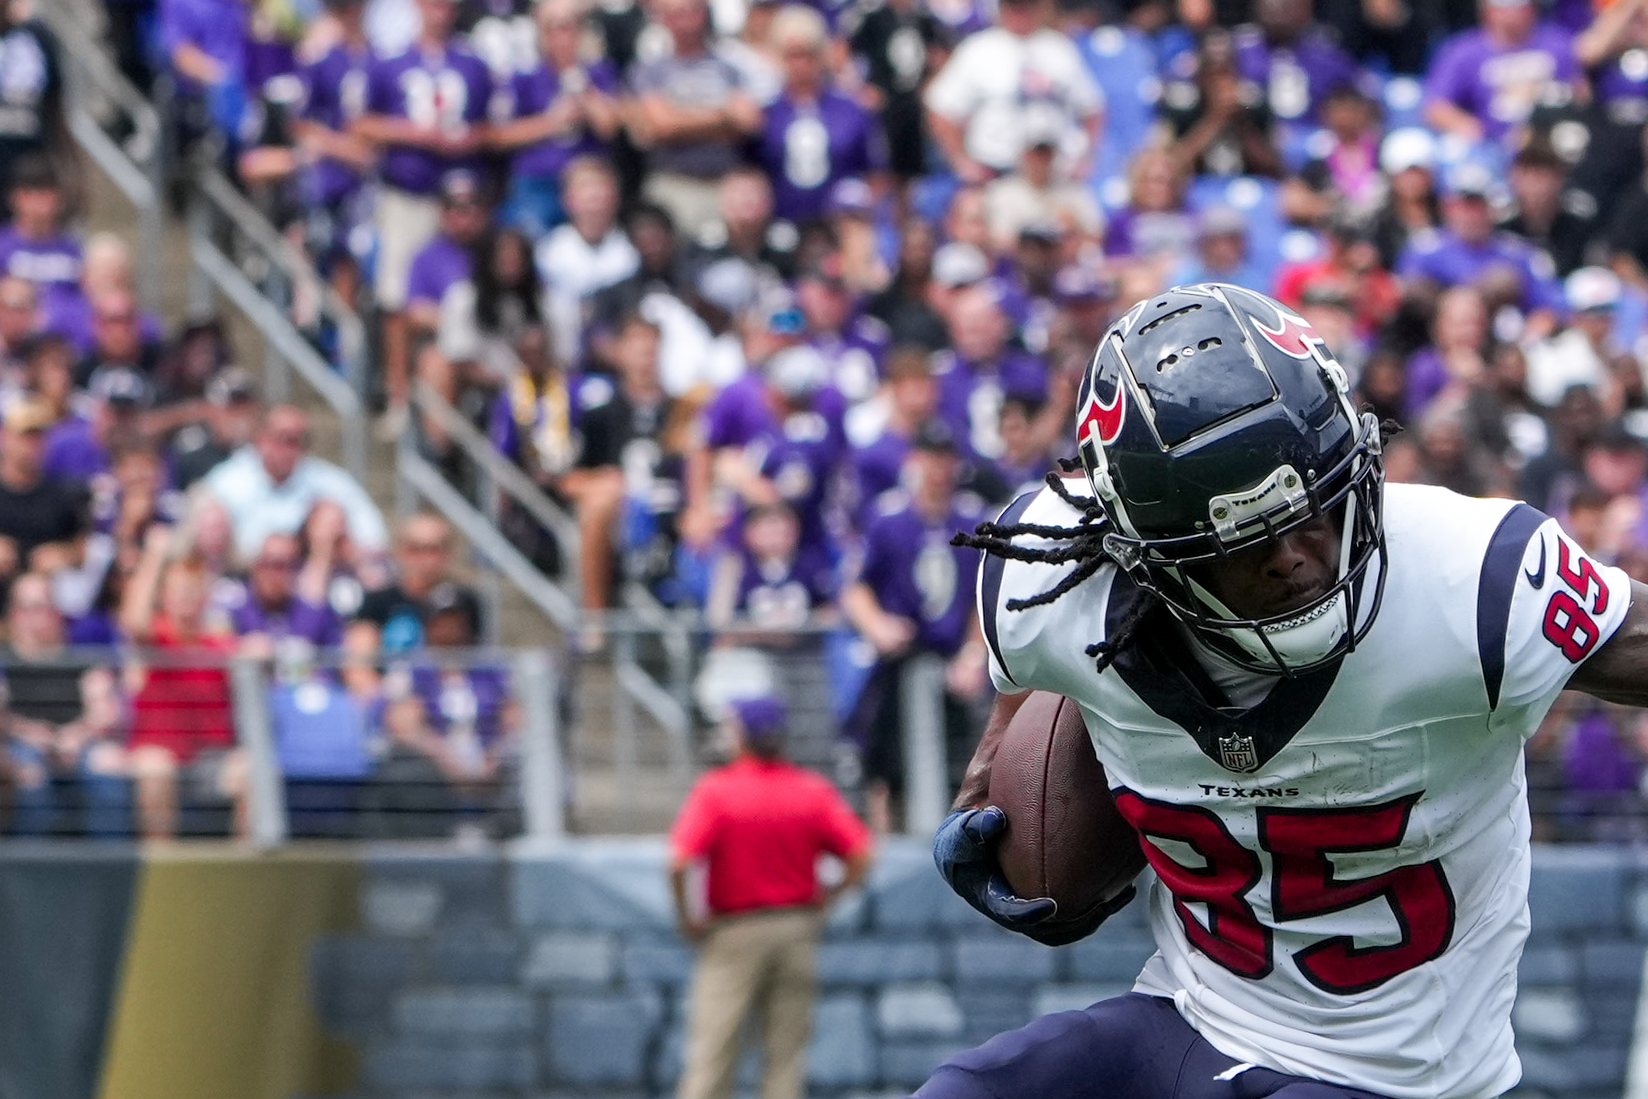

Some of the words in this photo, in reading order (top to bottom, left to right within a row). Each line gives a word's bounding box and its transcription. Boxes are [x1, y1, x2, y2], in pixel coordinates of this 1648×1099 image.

[1231, 481, 1277, 506] TEXANS
[1541, 534, 1610, 664] 85
[1226, 752, 1253, 769] NFL
[1197, 783, 1300, 798] TEXANS
[1112, 786, 1456, 996] 85
